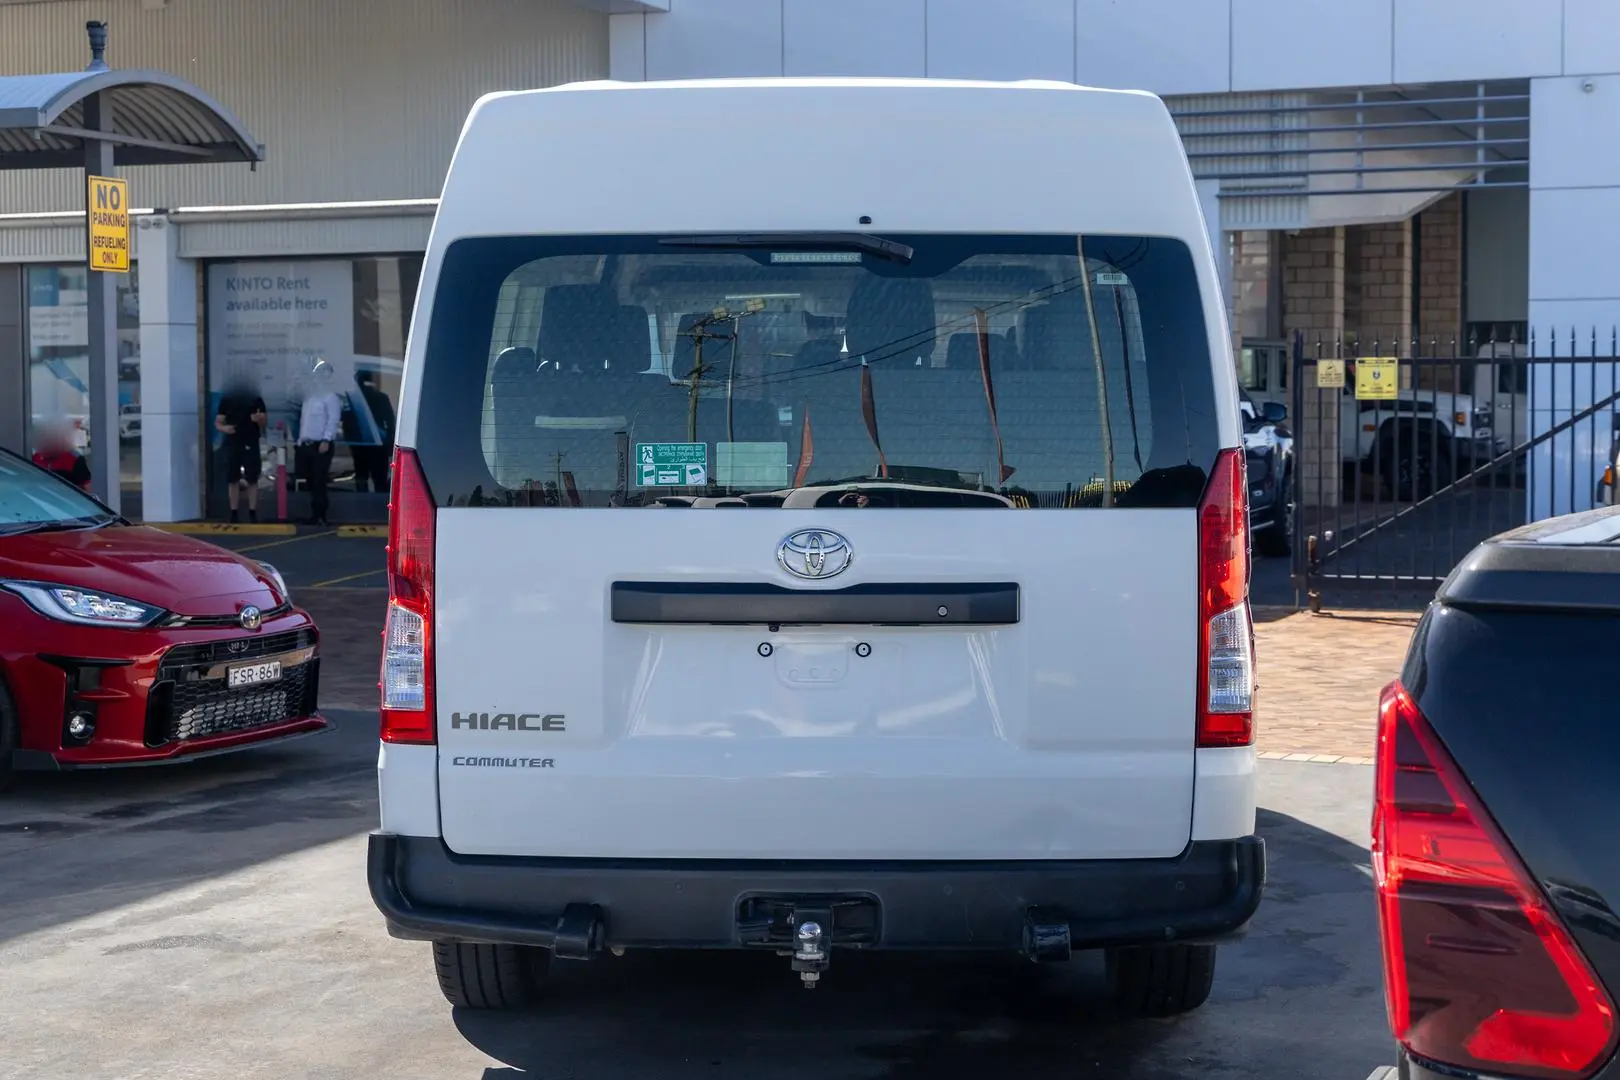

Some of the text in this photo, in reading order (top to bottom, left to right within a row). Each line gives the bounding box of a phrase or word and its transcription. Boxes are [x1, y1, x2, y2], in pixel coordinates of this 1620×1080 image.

[97, 184, 120, 210] NO
[93, 212, 125, 227] PARKING
[93, 236, 126, 250] REFUELING
[102, 251, 118, 264] ONLY
[226, 276, 310, 291] KINTO Rent
[226, 296, 328, 311] available here
[451, 712, 566, 731] HIACE
[453, 756, 555, 768] COMMUTER
